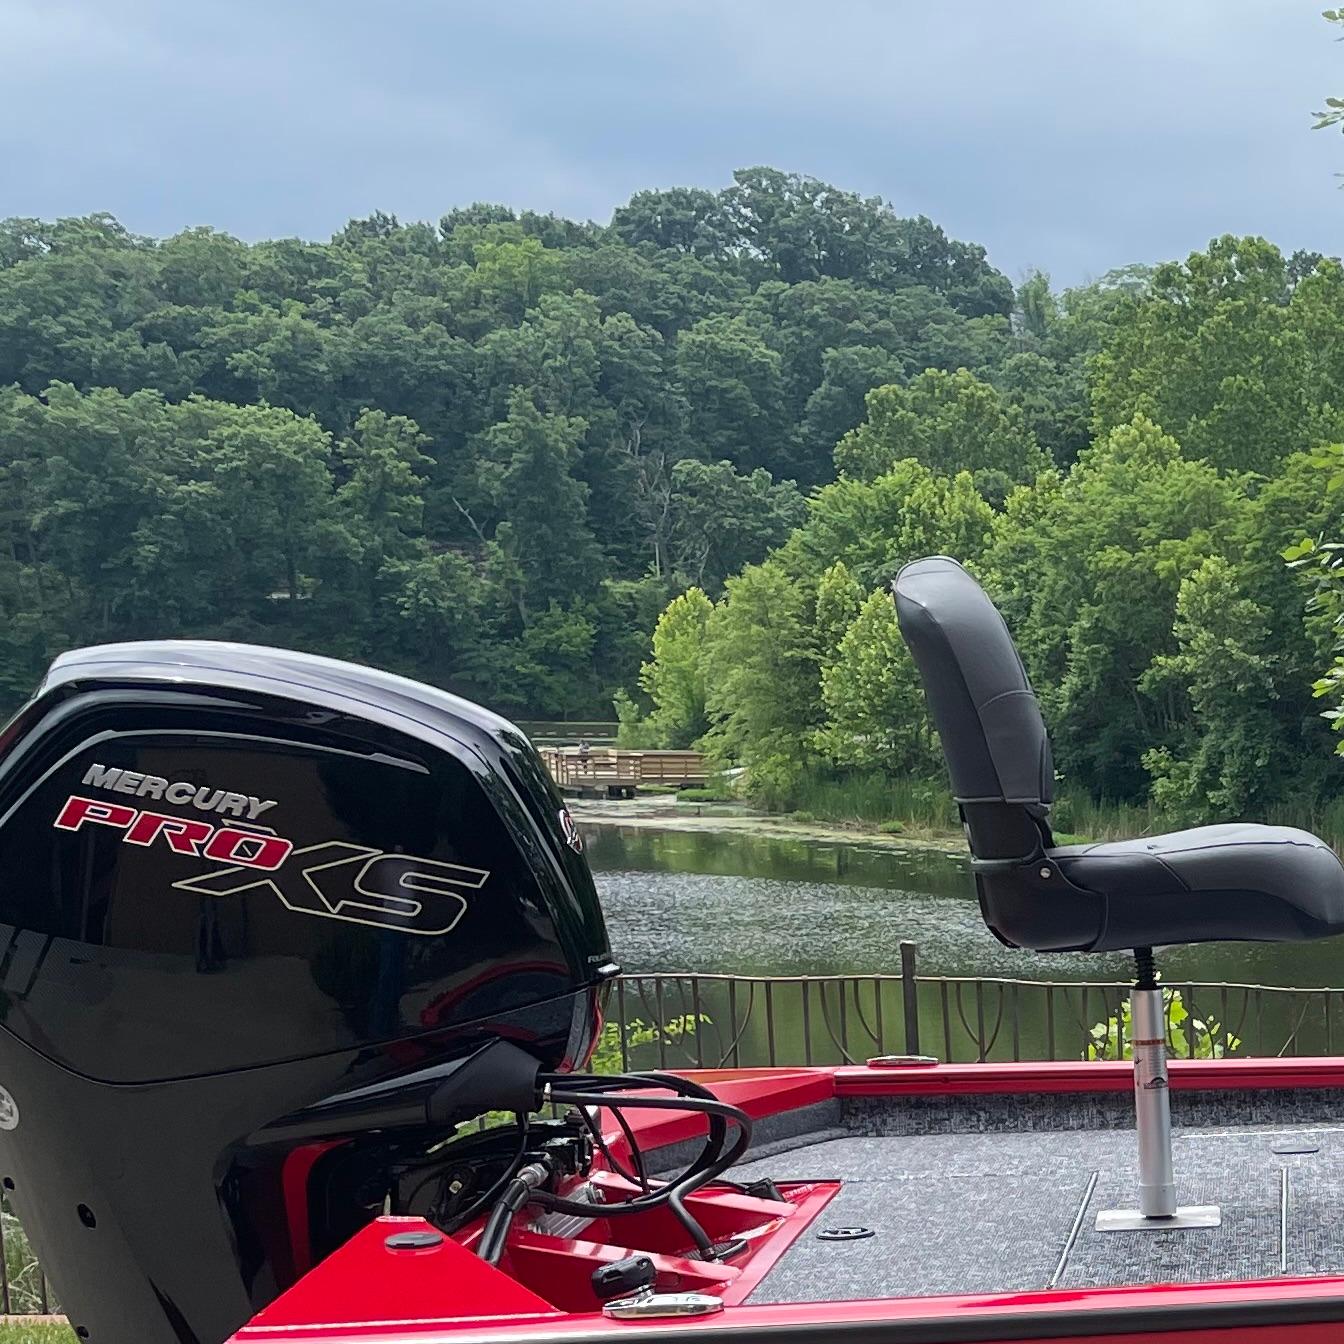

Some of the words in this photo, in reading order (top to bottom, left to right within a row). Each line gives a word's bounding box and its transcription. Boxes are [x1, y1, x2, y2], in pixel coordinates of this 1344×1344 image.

[81, 764, 278, 820] MERCURY
[53, 795, 294, 871] PRO
[171, 818, 490, 935] XS
